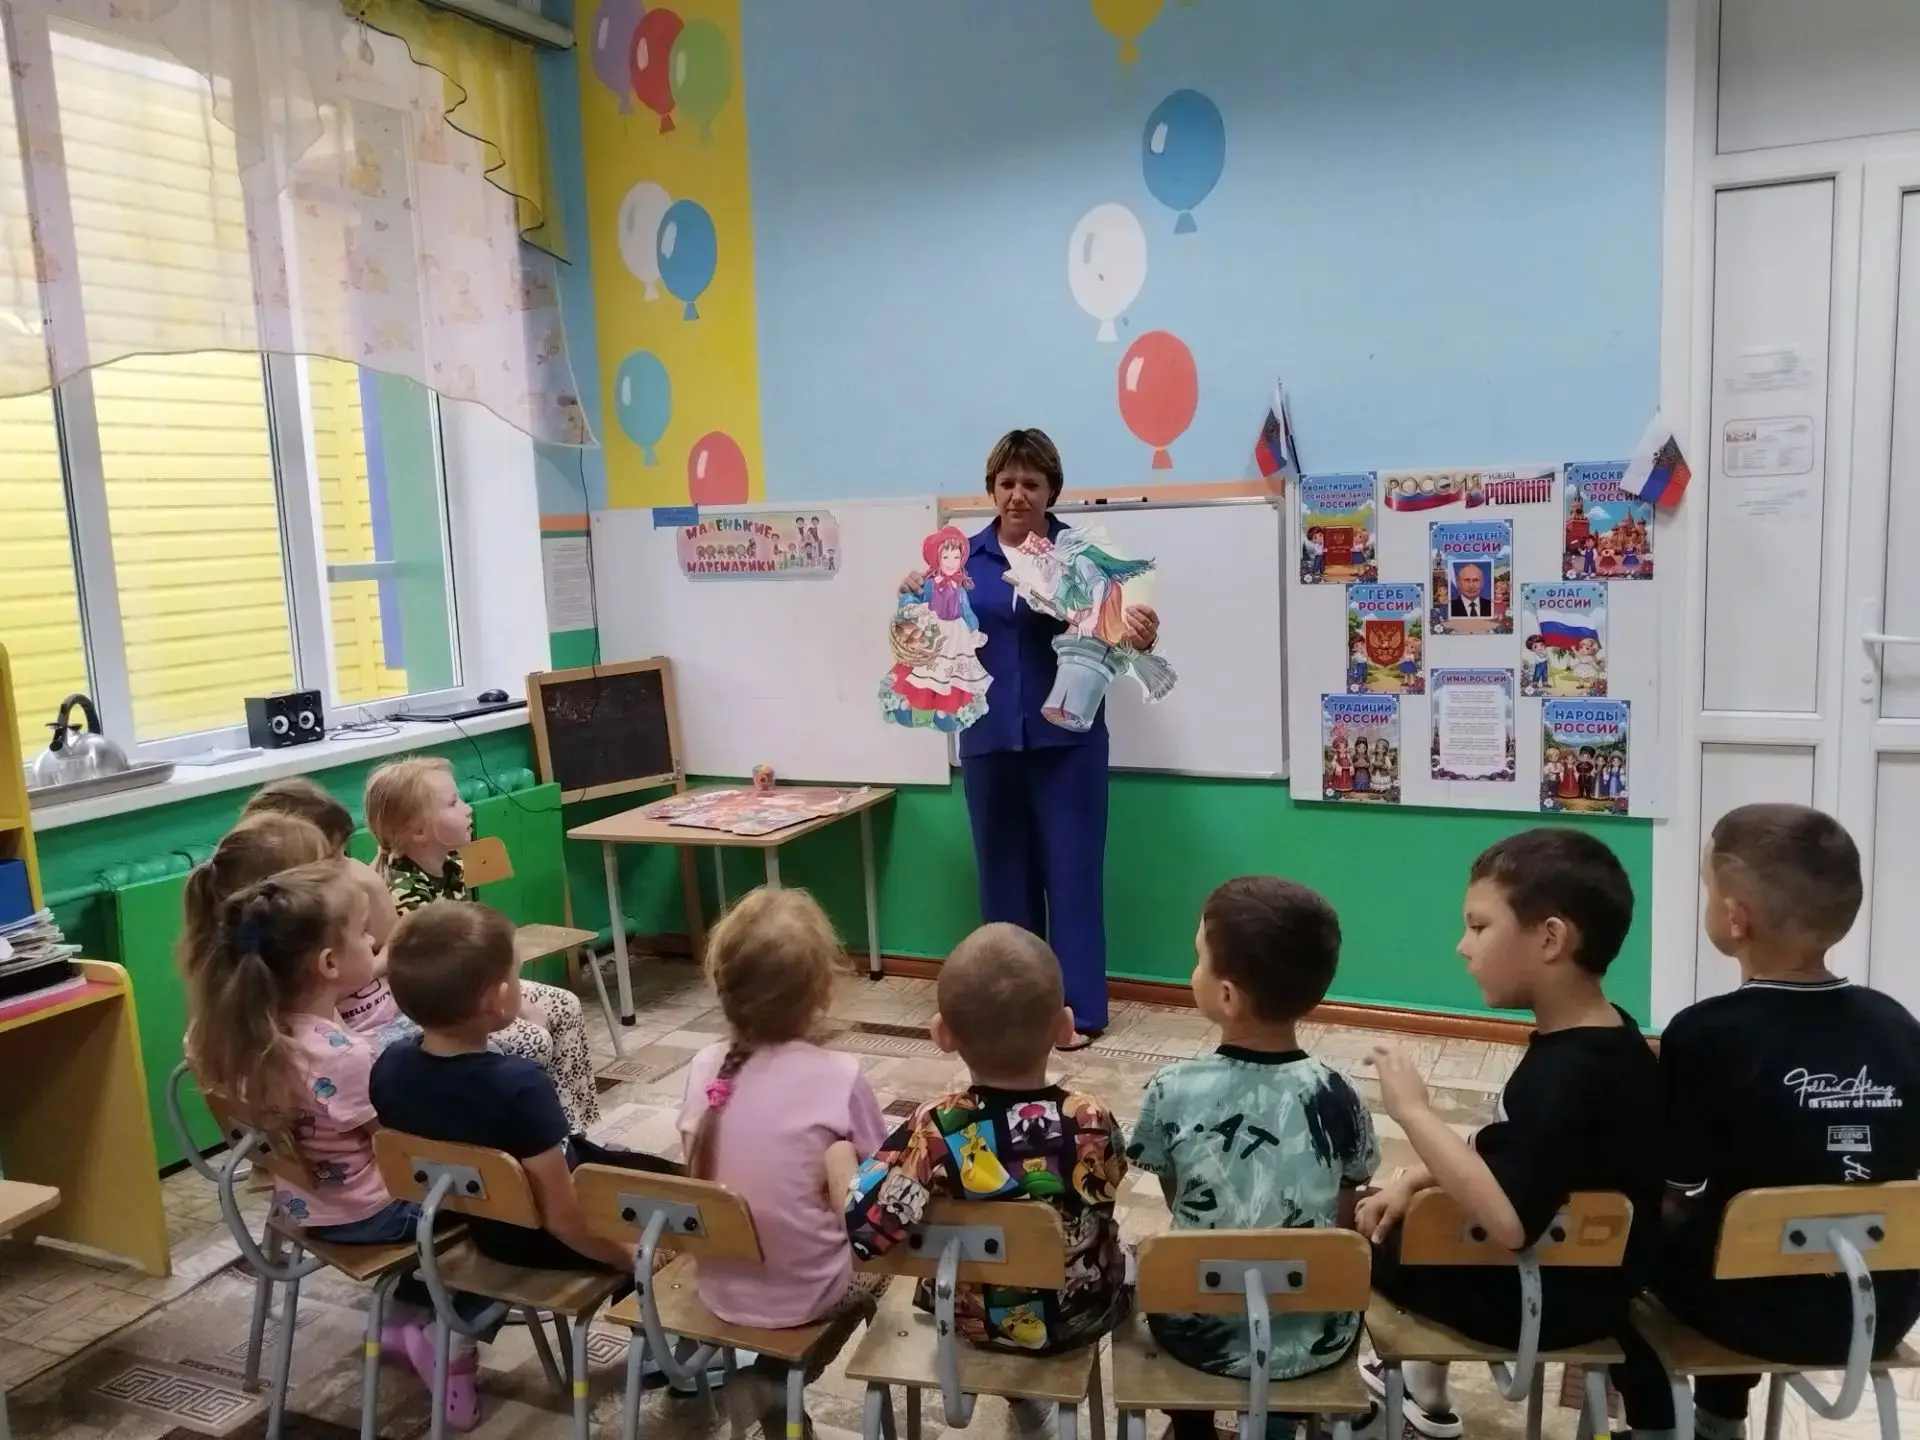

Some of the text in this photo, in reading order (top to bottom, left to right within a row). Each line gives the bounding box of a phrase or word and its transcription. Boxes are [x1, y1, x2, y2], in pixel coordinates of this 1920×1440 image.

[1582, 471, 1623, 481] МОСКВ
[1385, 472, 1482, 496] РОССИЯ
[1489, 472, 1516, 480] наша
[1583, 482, 1621, 492] СТОЛ
[1485, 478, 1553, 506] РОДИНА!
[1319, 500, 1358, 509] РОССИИ
[685, 518, 773, 541] МАЛЕНЬКИЕ
[1441, 531, 1504, 542] ПРЕЗИДЕНТ
[1444, 543, 1501, 553] РОССИИ
[687, 560, 776, 573] МАТЕМАТИКИ
[1368, 589, 1405, 600] ГЕРБ
[1546, 588, 1583, 597] ФЛАГ
[1358, 601, 1414, 611] РОССИИ
[1539, 599, 1592, 609] РОССИИ
[1441, 675, 1506, 683] ГИМН РОССИИ
[1333, 703, 1392, 713] ТРАДИЦИИ
[1335, 713, 1389, 724] РОССИИ
[1555, 710, 1618, 721] НАРОДЫ
[1554, 723, 1619, 734] РОССИИ
[340, 1002, 372, 1020] HELLO
